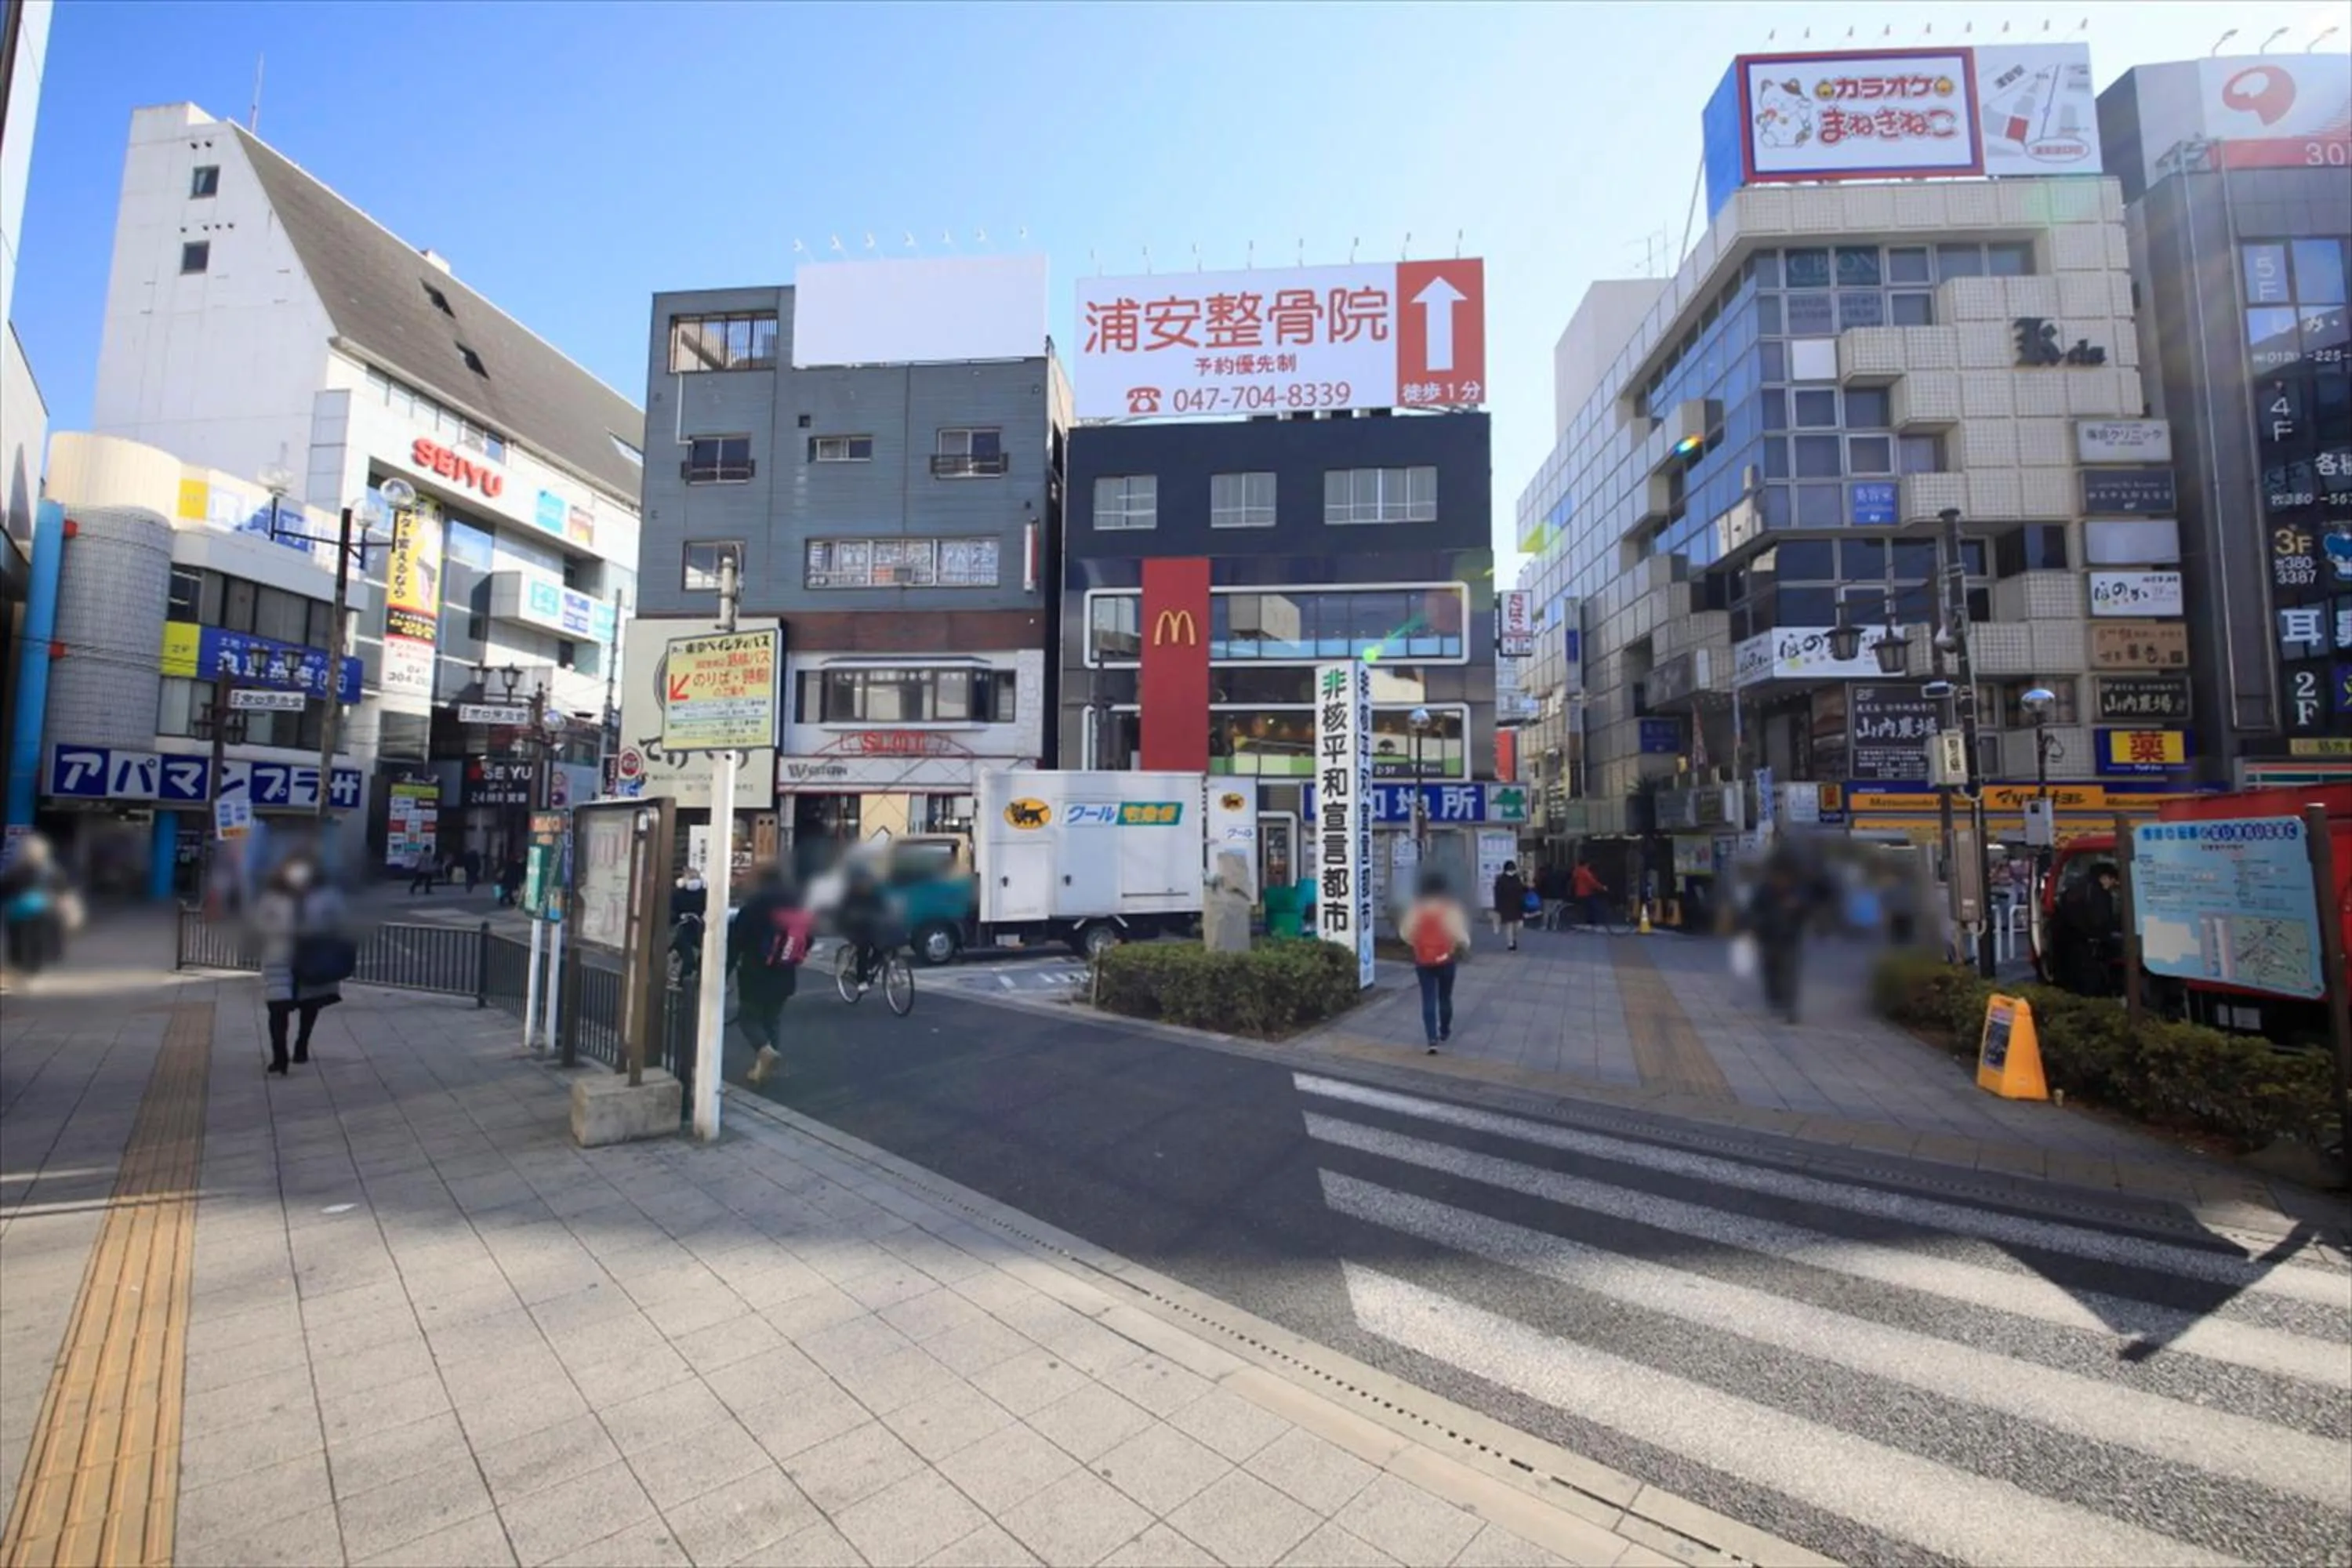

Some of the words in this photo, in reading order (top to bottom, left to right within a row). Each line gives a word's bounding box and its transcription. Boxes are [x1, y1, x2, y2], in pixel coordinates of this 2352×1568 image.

[1835, 76, 1935, 100] カラオケ
[1819, 108, 1957, 144] まねきねこ
[1085, 285, 1388, 354] 浦安整骨院
[1195, 353, 1297, 377] 予約優先制
[1173, 381, 1352, 412] 047-704-8339
[412, 437, 503, 498] SEIYU
[2275, 528, 2313, 554] 3F
[2277, 569, 2317, 584] 3387
[2295, 671, 2318, 726] 2F
[2129, 731, 2165, 761] 薬
[60, 750, 360, 805] アパマンプラザ
[1321, 668, 1348, 933] 非核平和宣言都市
